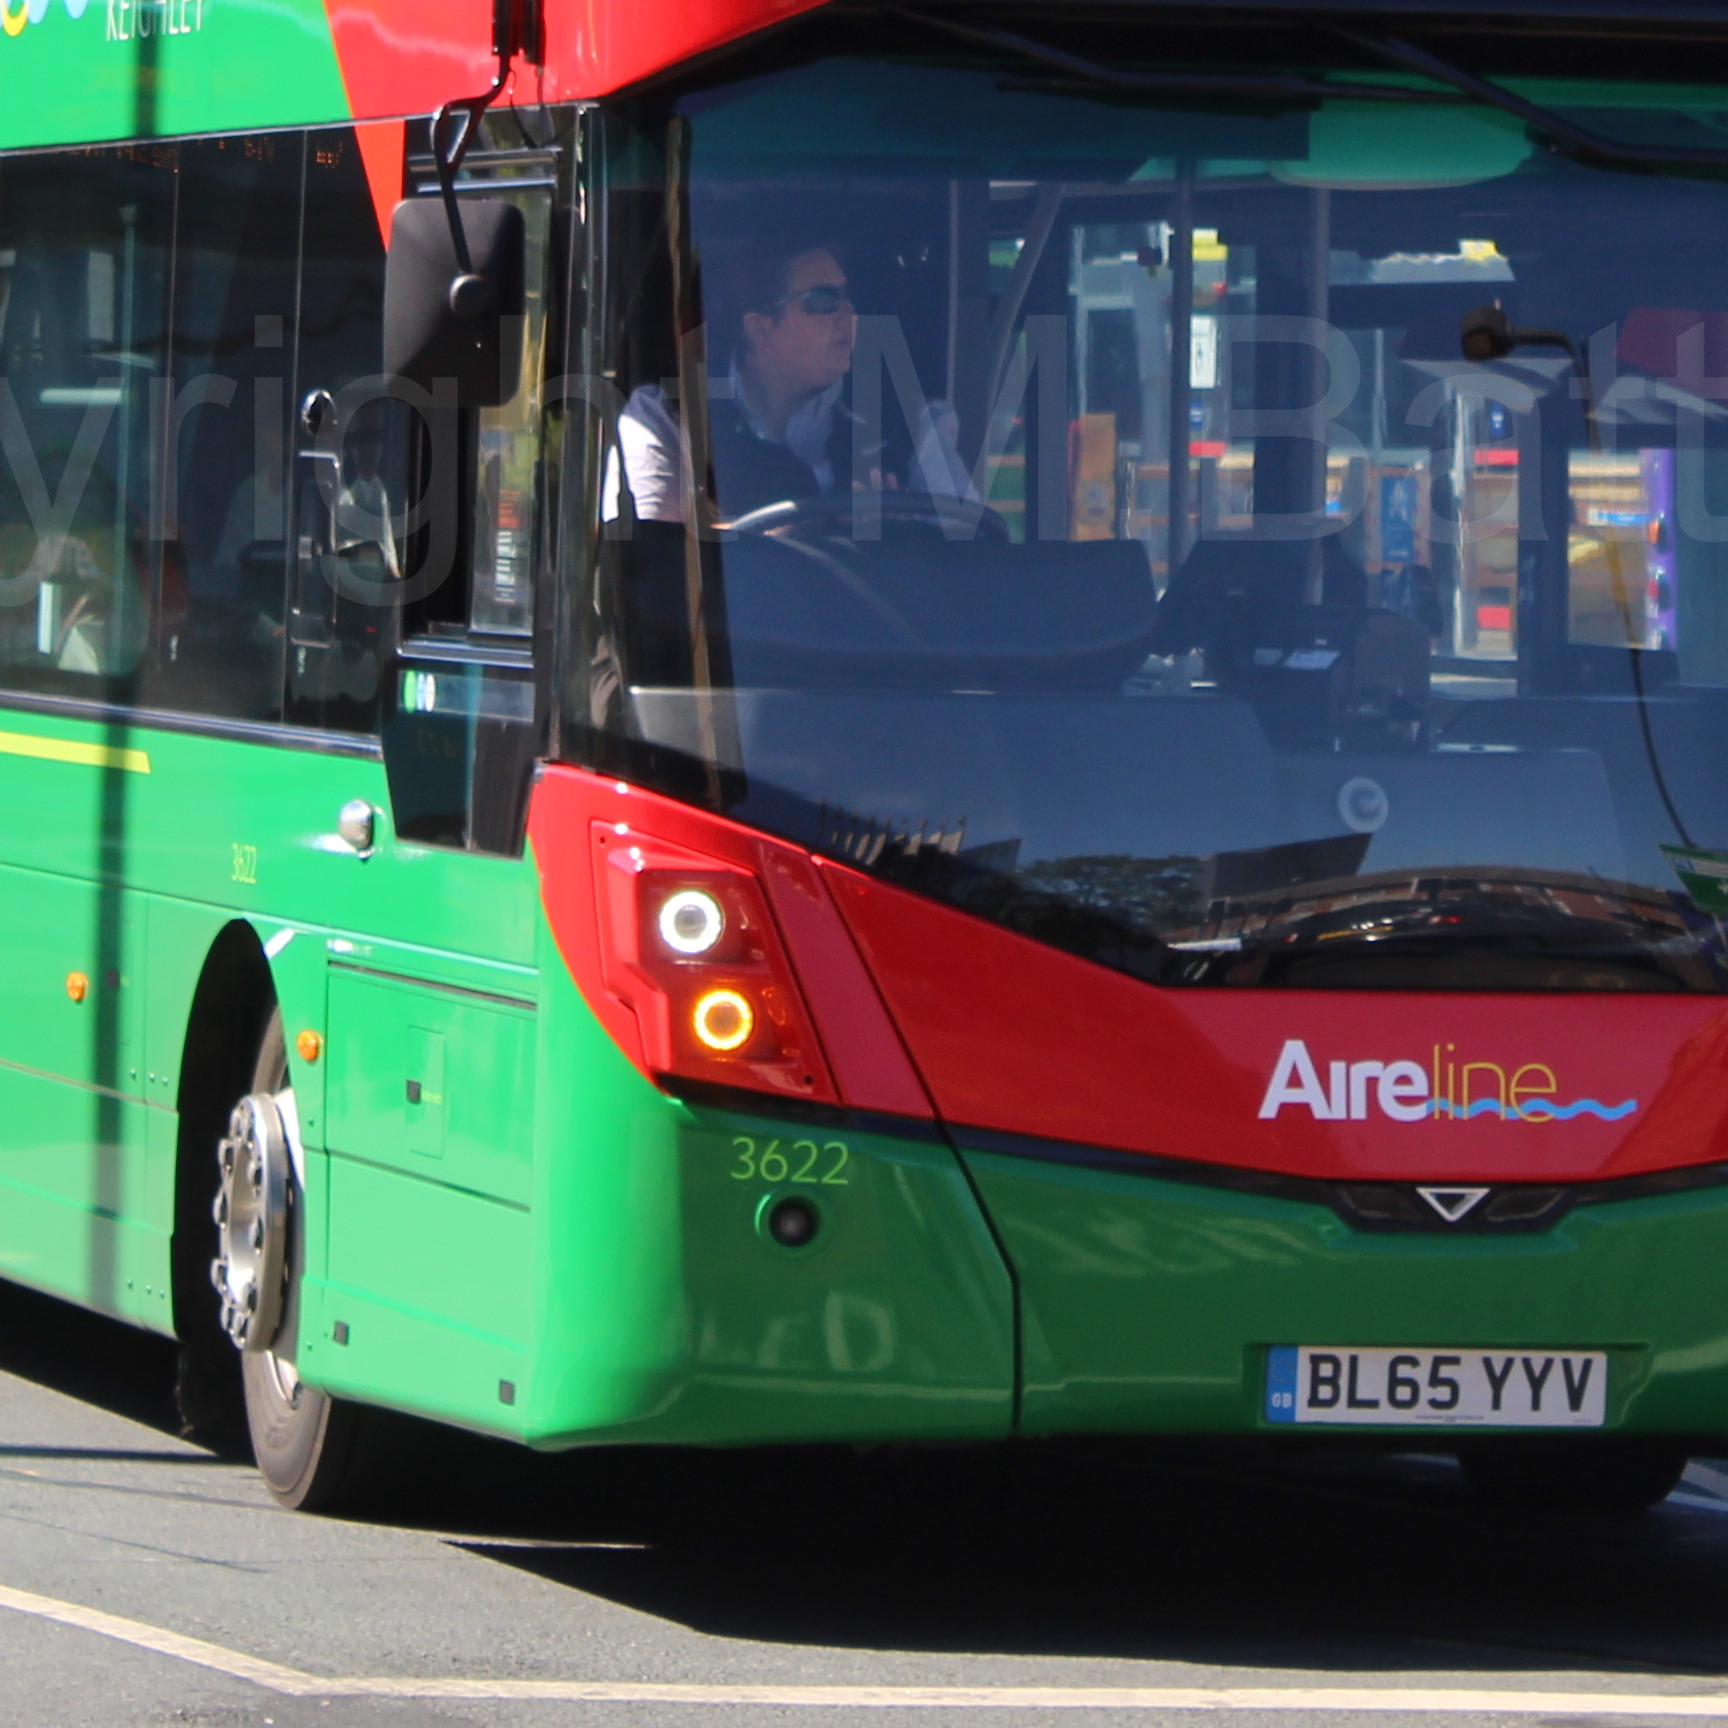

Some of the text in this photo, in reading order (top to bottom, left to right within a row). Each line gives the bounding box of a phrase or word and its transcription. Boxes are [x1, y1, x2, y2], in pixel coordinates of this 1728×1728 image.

[232, 842, 257, 884] 3622
[1258, 1039, 1558, 1123] Aireline
[729, 1137, 849, 1186] 3622
[1272, 1393, 1292, 1407] GB
[1308, 1353, 1593, 1412] BL65 YYV
